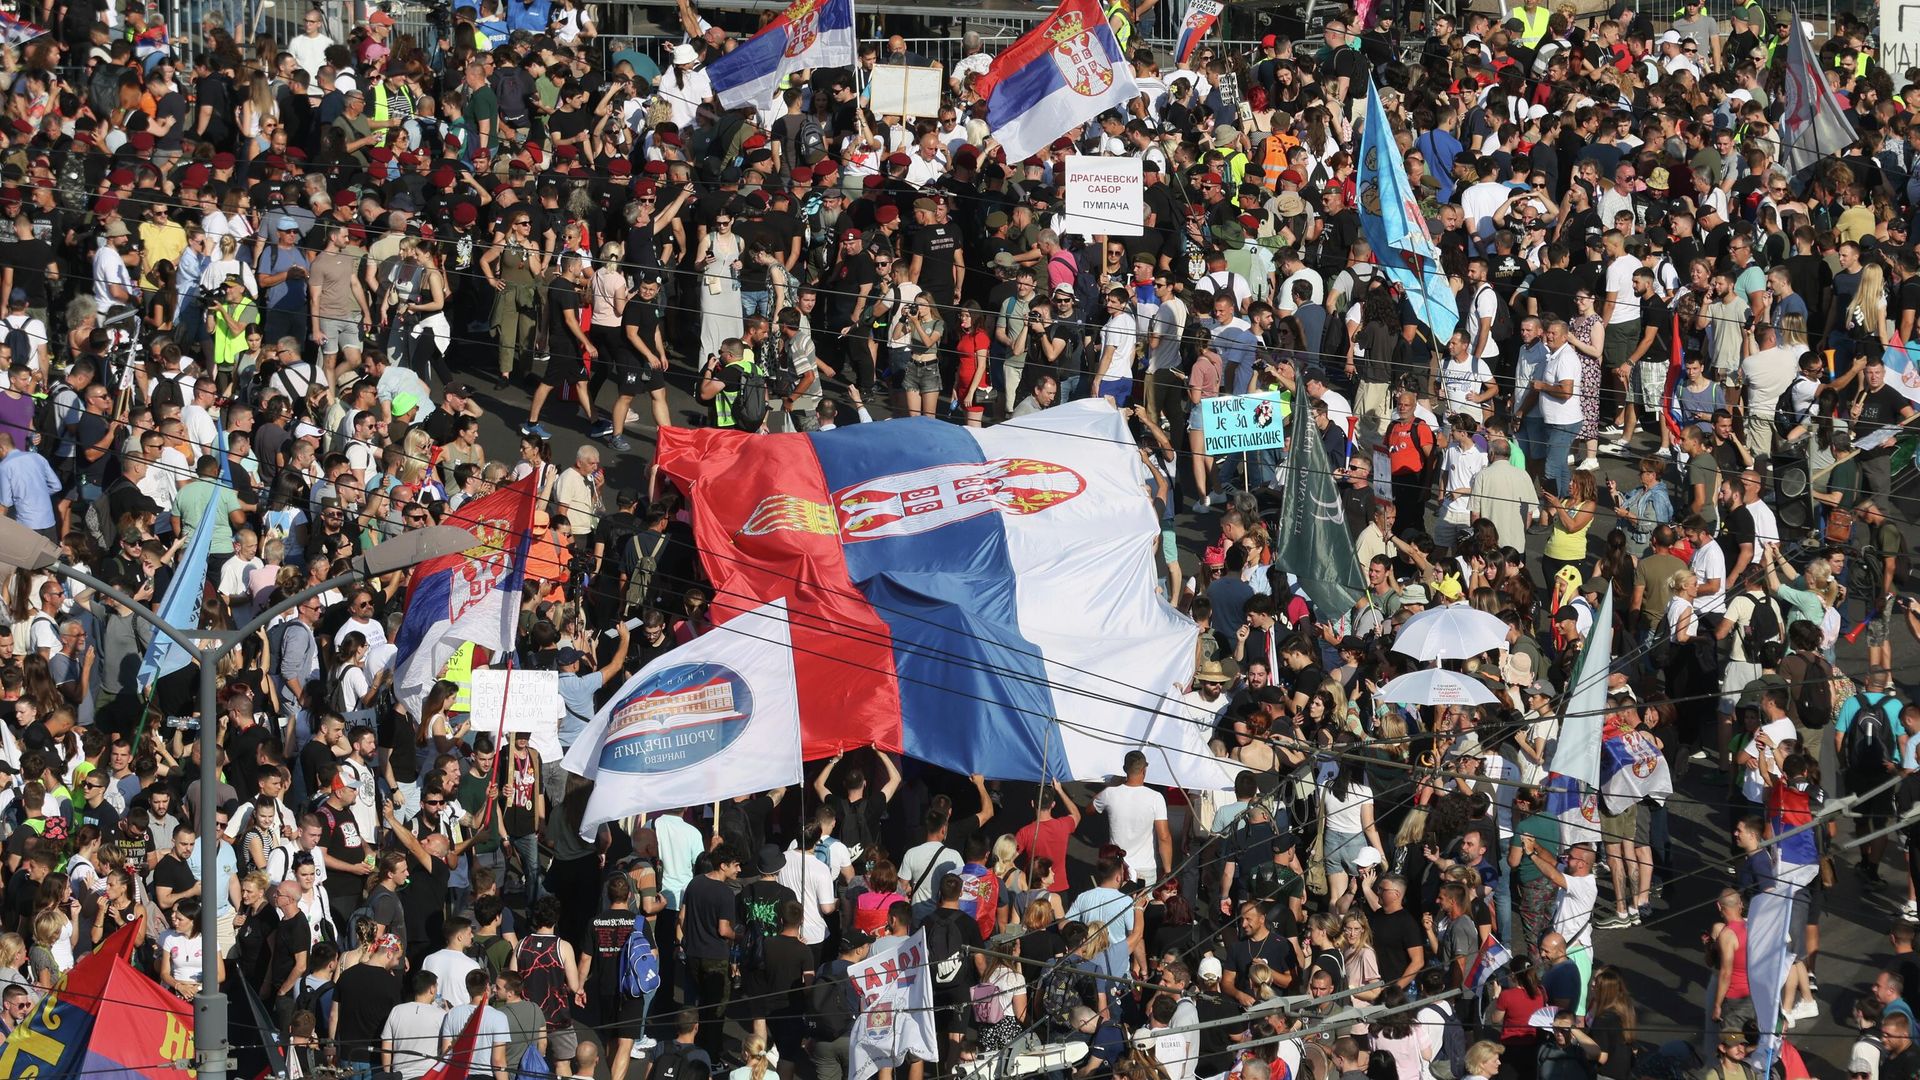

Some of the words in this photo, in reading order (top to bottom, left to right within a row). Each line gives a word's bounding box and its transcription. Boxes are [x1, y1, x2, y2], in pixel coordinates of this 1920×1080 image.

[1070, 174, 1139, 184] ДРАГАЧЕВСКИ
[1088, 185, 1121, 194] САБОР
[1083, 201, 1130, 211] ПУМПАЧА
[1212, 398, 1246, 415] ВРЕМЕ
[1216, 416, 1228, 431] ЈЕ
[1235, 414, 1248, 428] ЗА
[1205, 430, 1282, 451] РАСПЕТЉАВАЊЕ
[937, 951, 960, 978] NIKE
